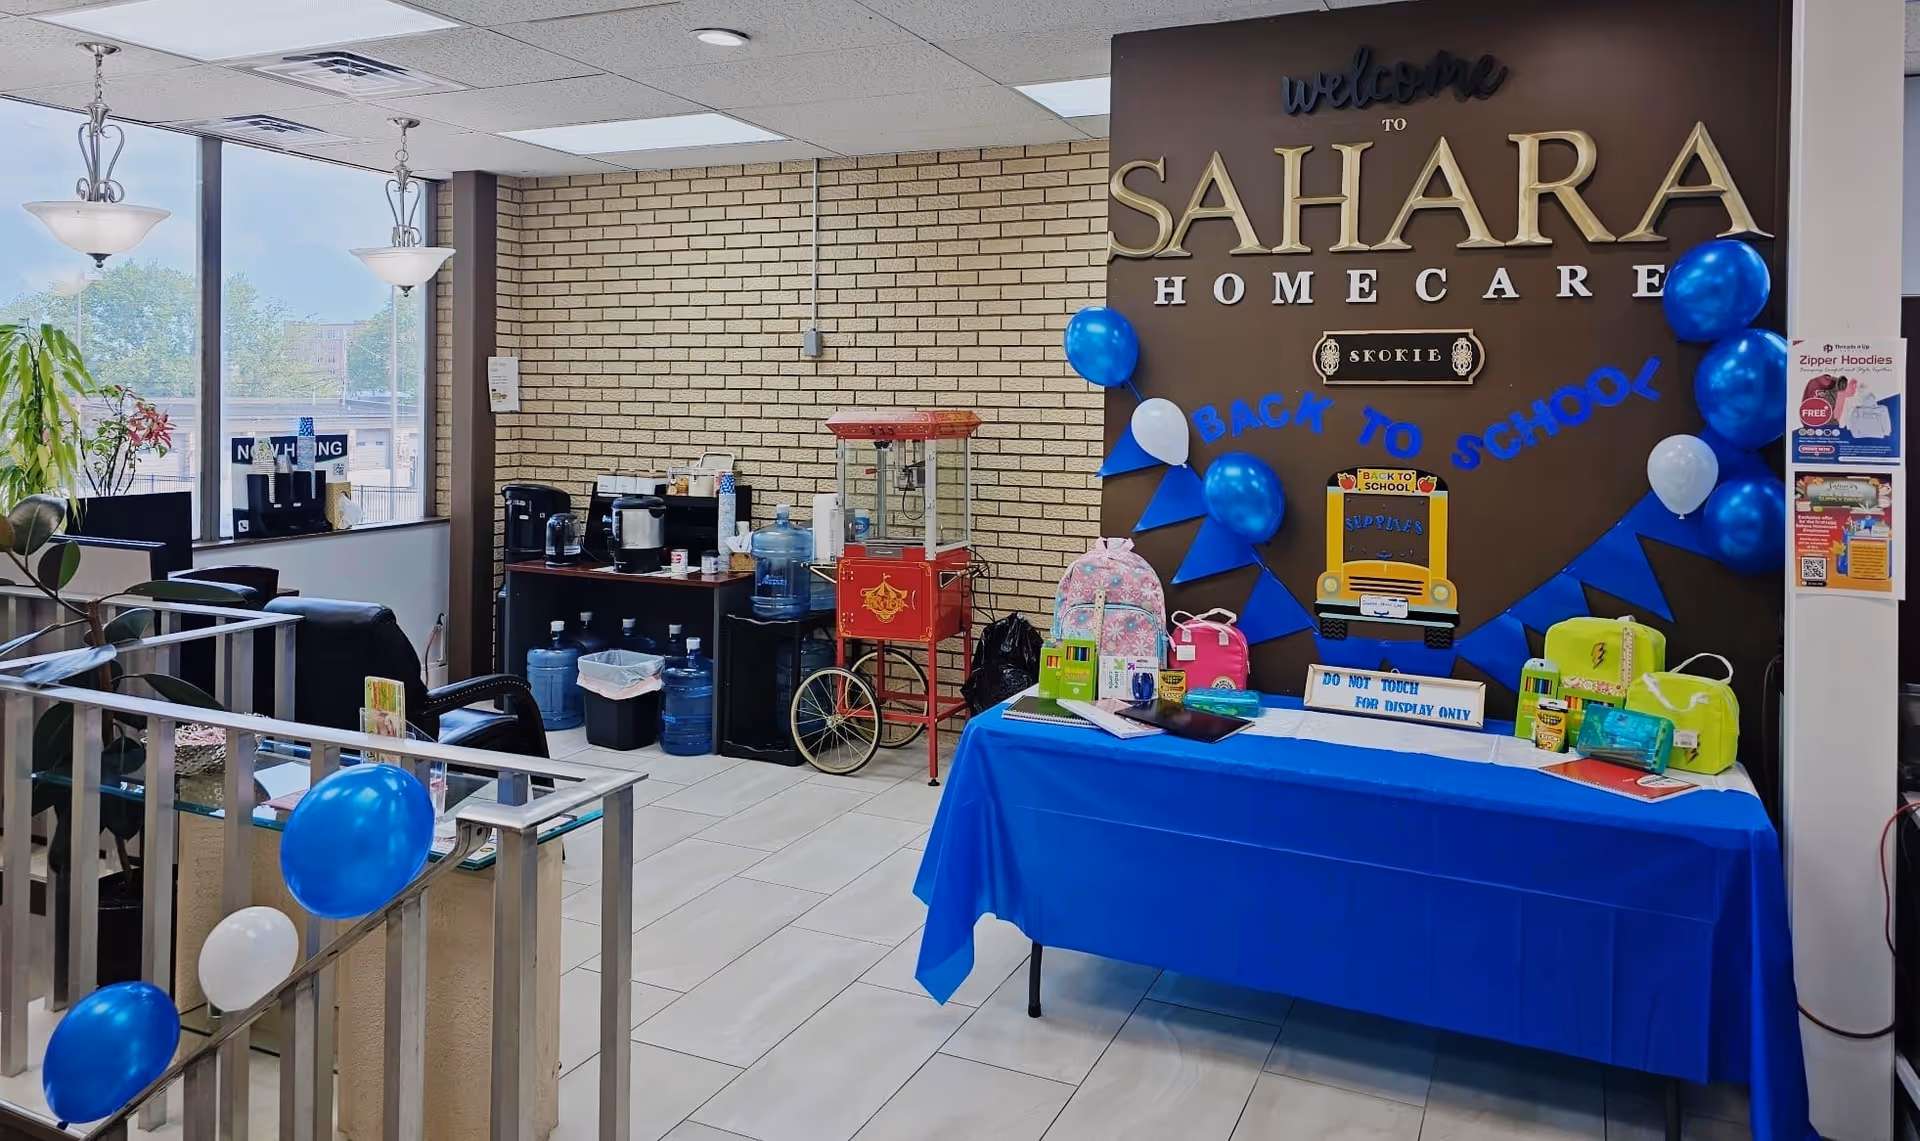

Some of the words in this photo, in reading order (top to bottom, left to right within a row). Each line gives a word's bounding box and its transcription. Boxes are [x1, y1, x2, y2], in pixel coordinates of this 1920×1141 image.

[1281, 45, 1509, 116] welcome
[1382, 117, 1407, 133] TO
[1107, 120, 1775, 263] SAHARA
[1153, 264, 1669, 306] HOMECARE
[1348, 348, 1442, 363] SKOKIE
[1800, 355, 1838, 367] Zipper
[1841, 354, 1893, 365] Hoodies
[1191, 390, 1335, 446] BACK
[1356, 406, 1424, 460] TO
[1450, 355, 1665, 472] SCHOOL
[1802, 409, 1826, 418] FREE
[1363, 471, 1395, 481] BACK
[1397, 472, 1413, 482] TO
[1364, 482, 1411, 492] SCHOOL
[1322, 672, 1341, 687] DO
[1349, 675, 1371, 689] NOT
[1381, 678, 1420, 695] TOUCH
[1355, 696, 1379, 710] FOR
[1384, 700, 1435, 717] DISPLAY
[1438, 706, 1472, 721] ONLY
